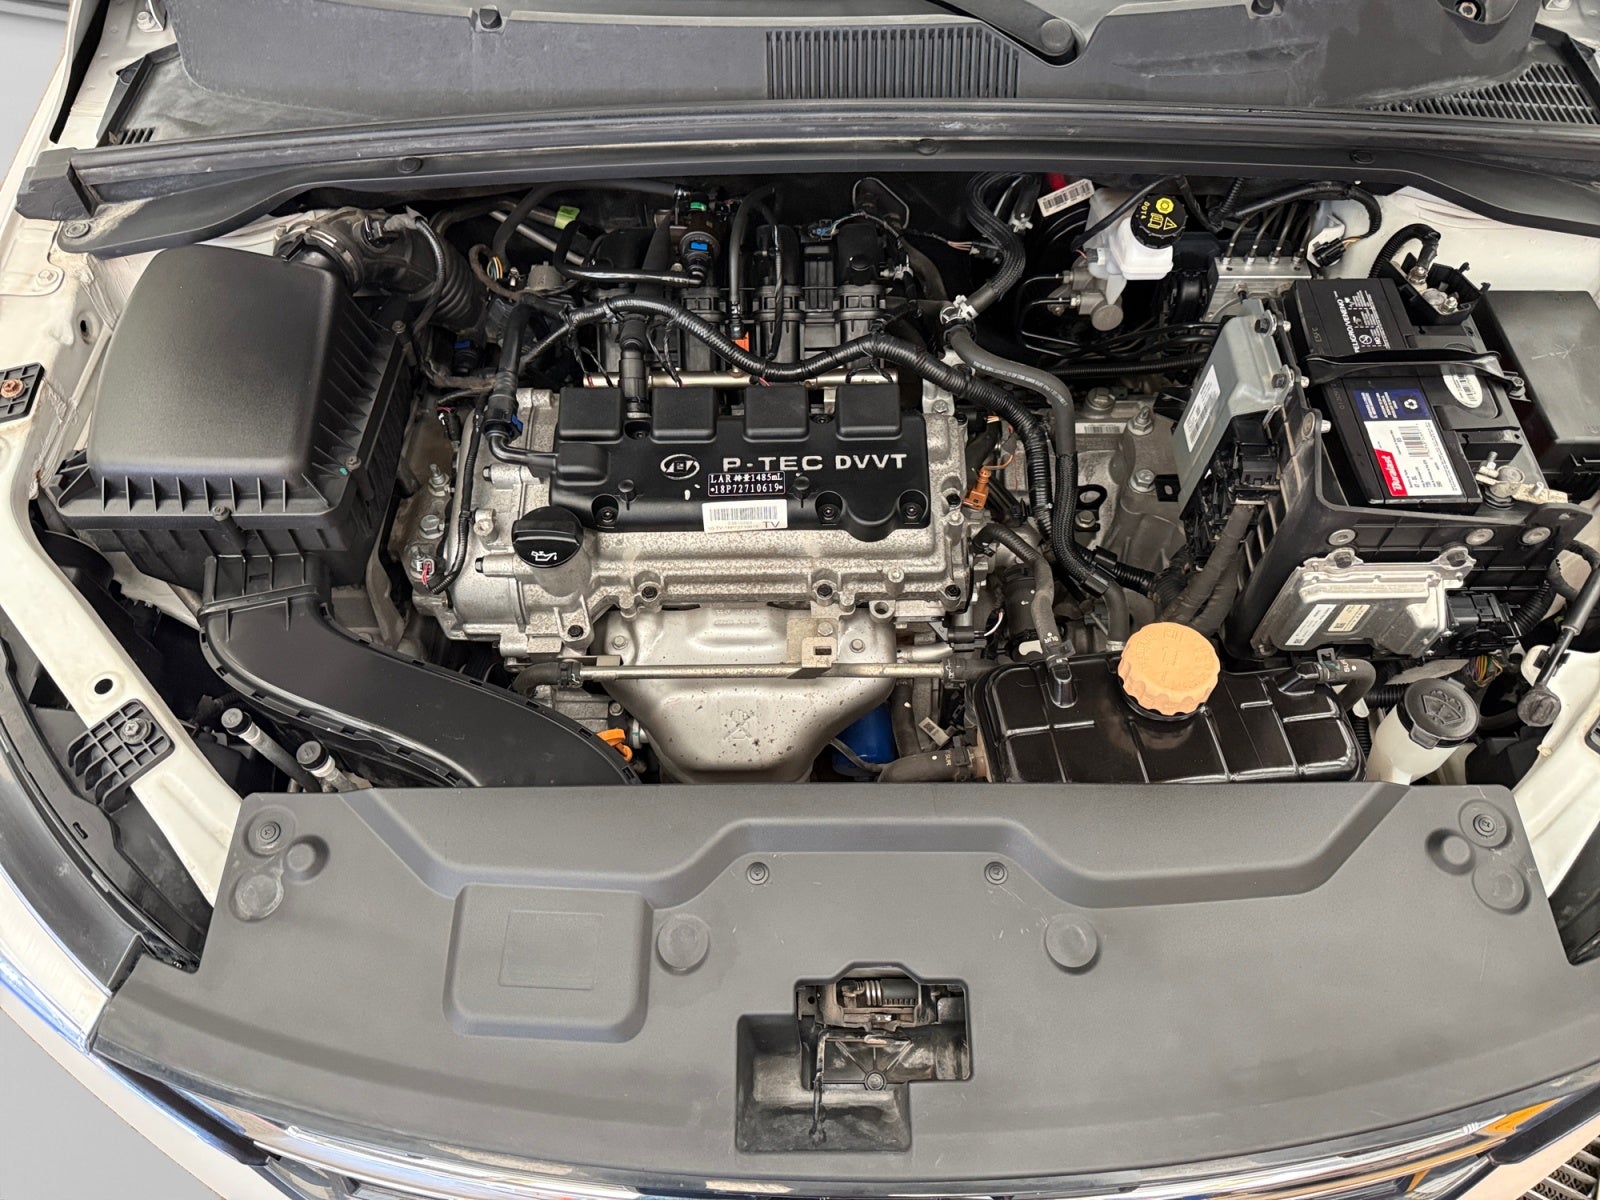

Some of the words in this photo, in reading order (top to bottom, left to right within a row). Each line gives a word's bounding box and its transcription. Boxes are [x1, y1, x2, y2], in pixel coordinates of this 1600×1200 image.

[1141, 201, 1151, 220] DOT4
[1337, 299, 1360, 353] PELIGRO/VENENO
[835, 453, 908, 470] DVVT
[710, 473, 732, 483] LAR
[1381, 455, 1403, 492] Duralast
